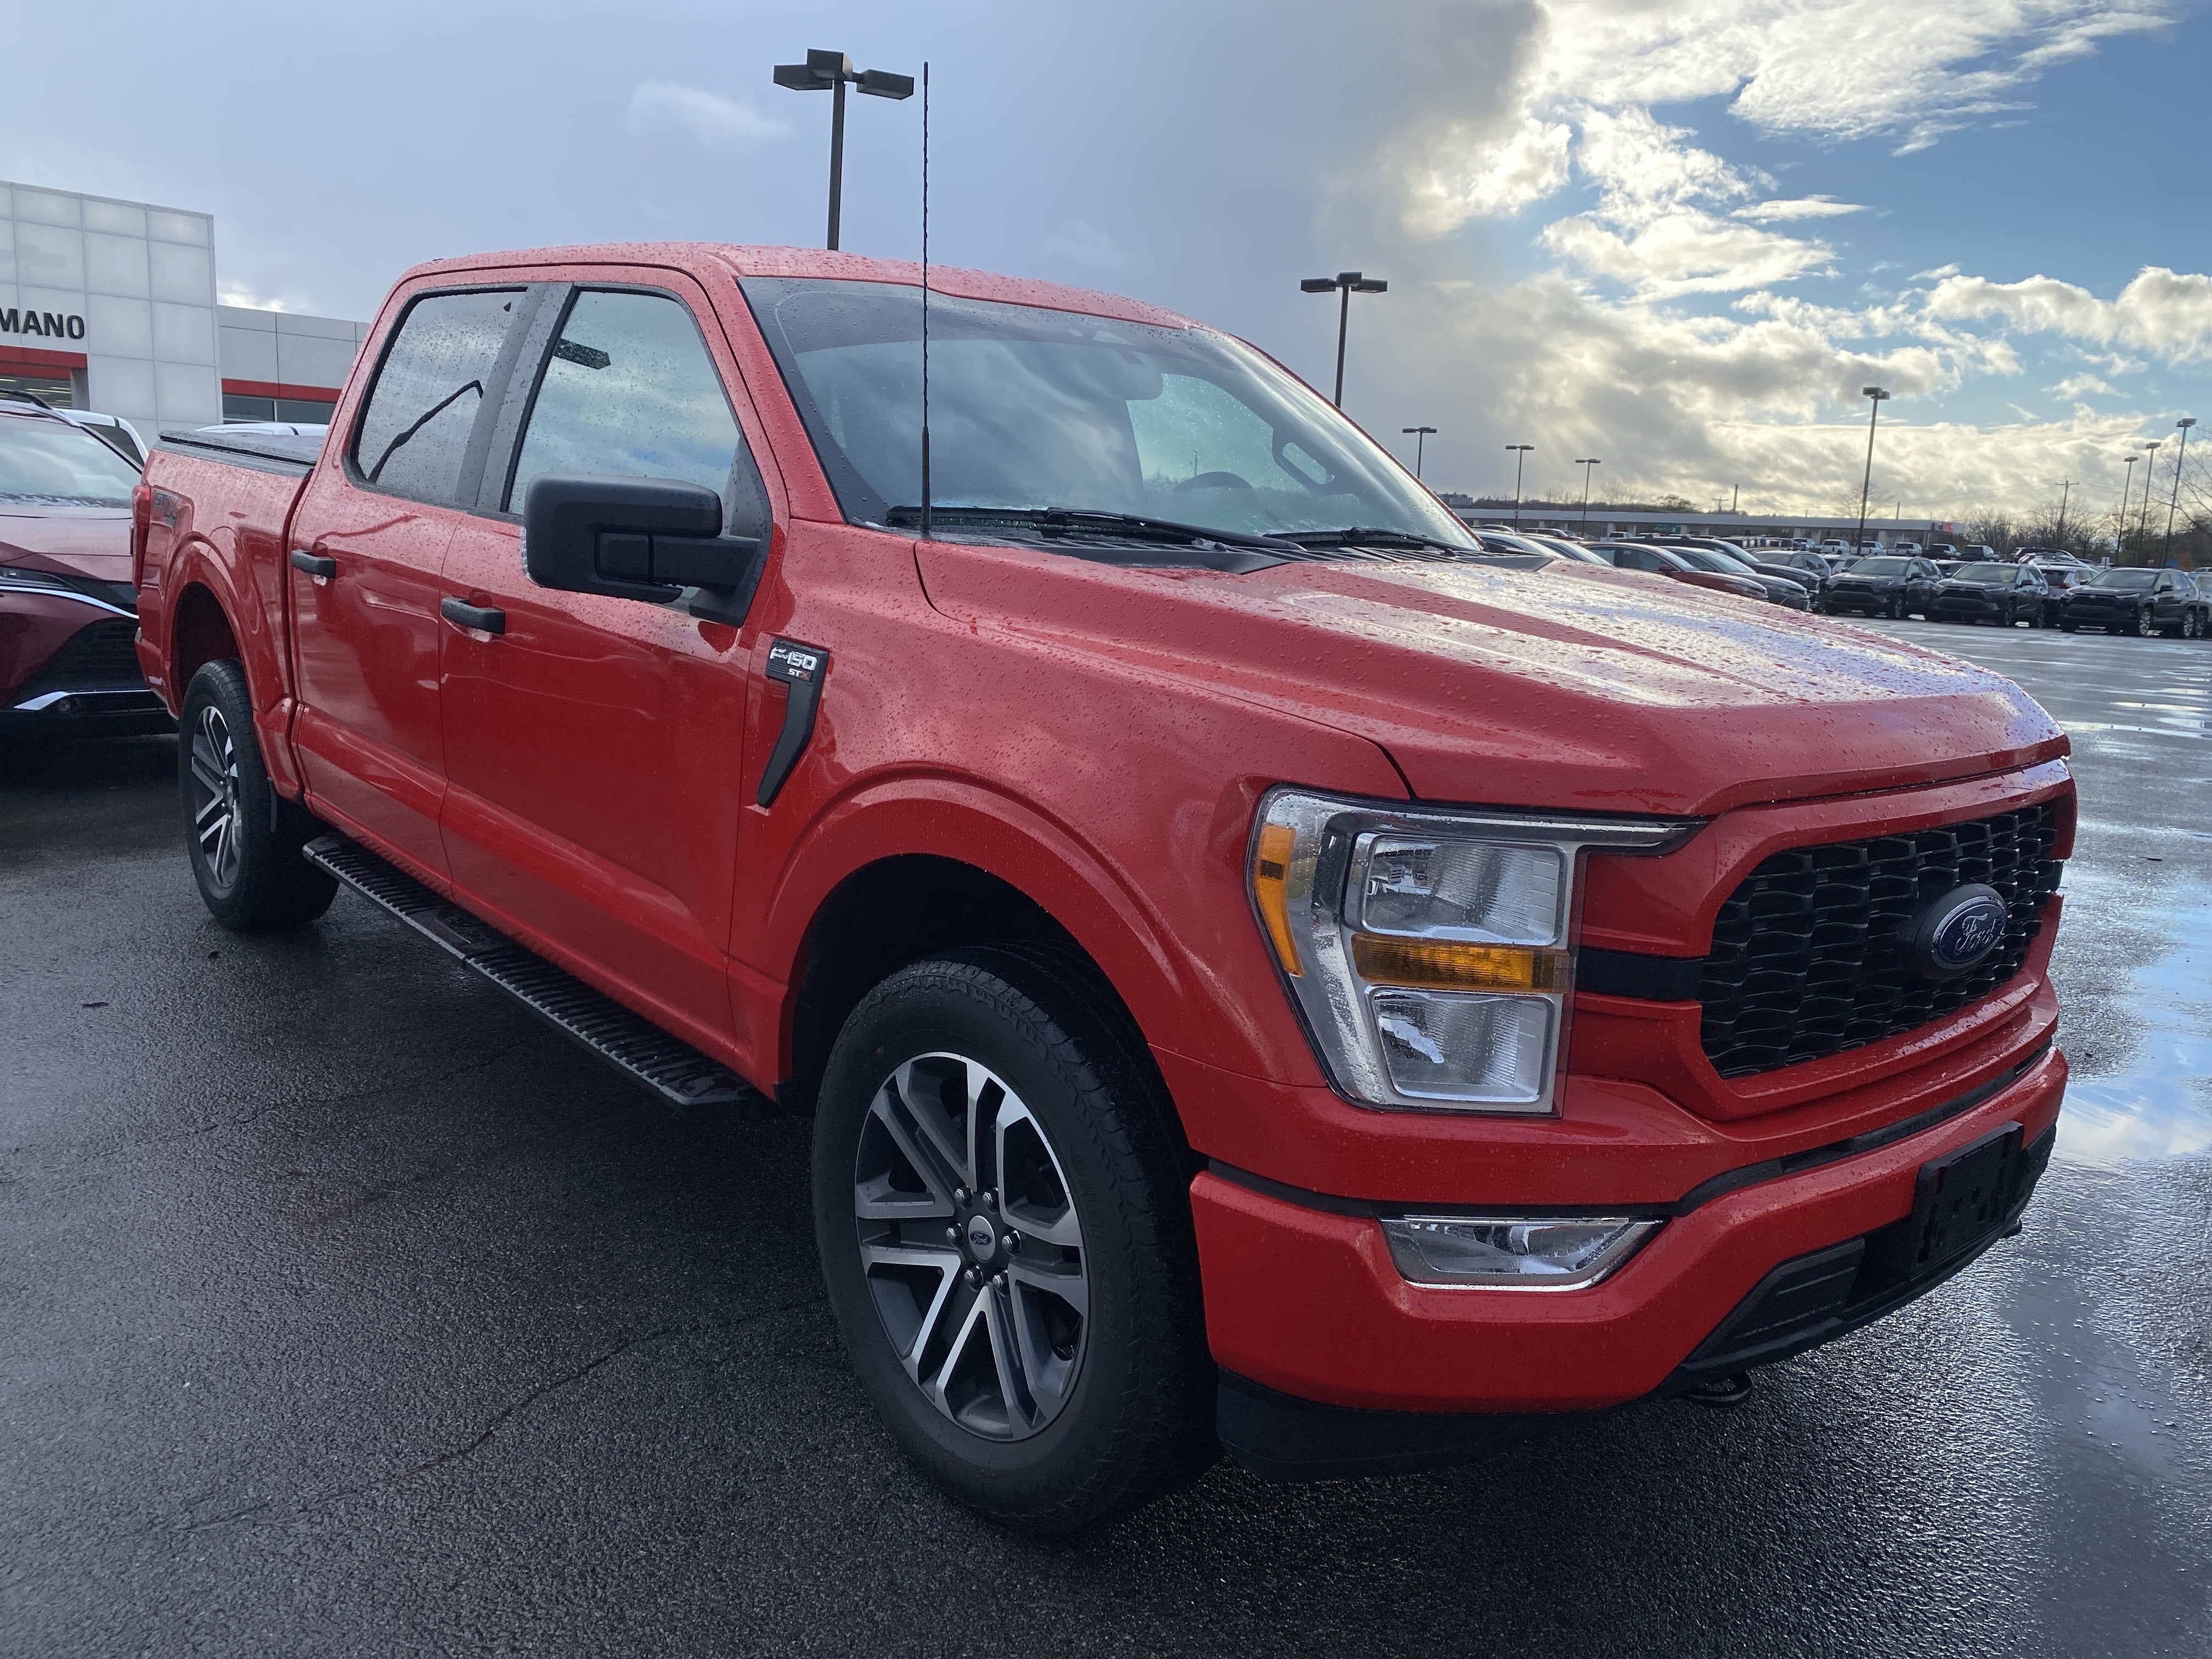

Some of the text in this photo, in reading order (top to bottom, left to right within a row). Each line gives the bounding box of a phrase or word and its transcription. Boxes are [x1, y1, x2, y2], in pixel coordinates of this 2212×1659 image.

[770, 647, 817, 670] F-150
[788, 668, 810, 680] STX
[1955, 913, 1997, 956] Ford
[974, 1233, 988, 1244] Ford
